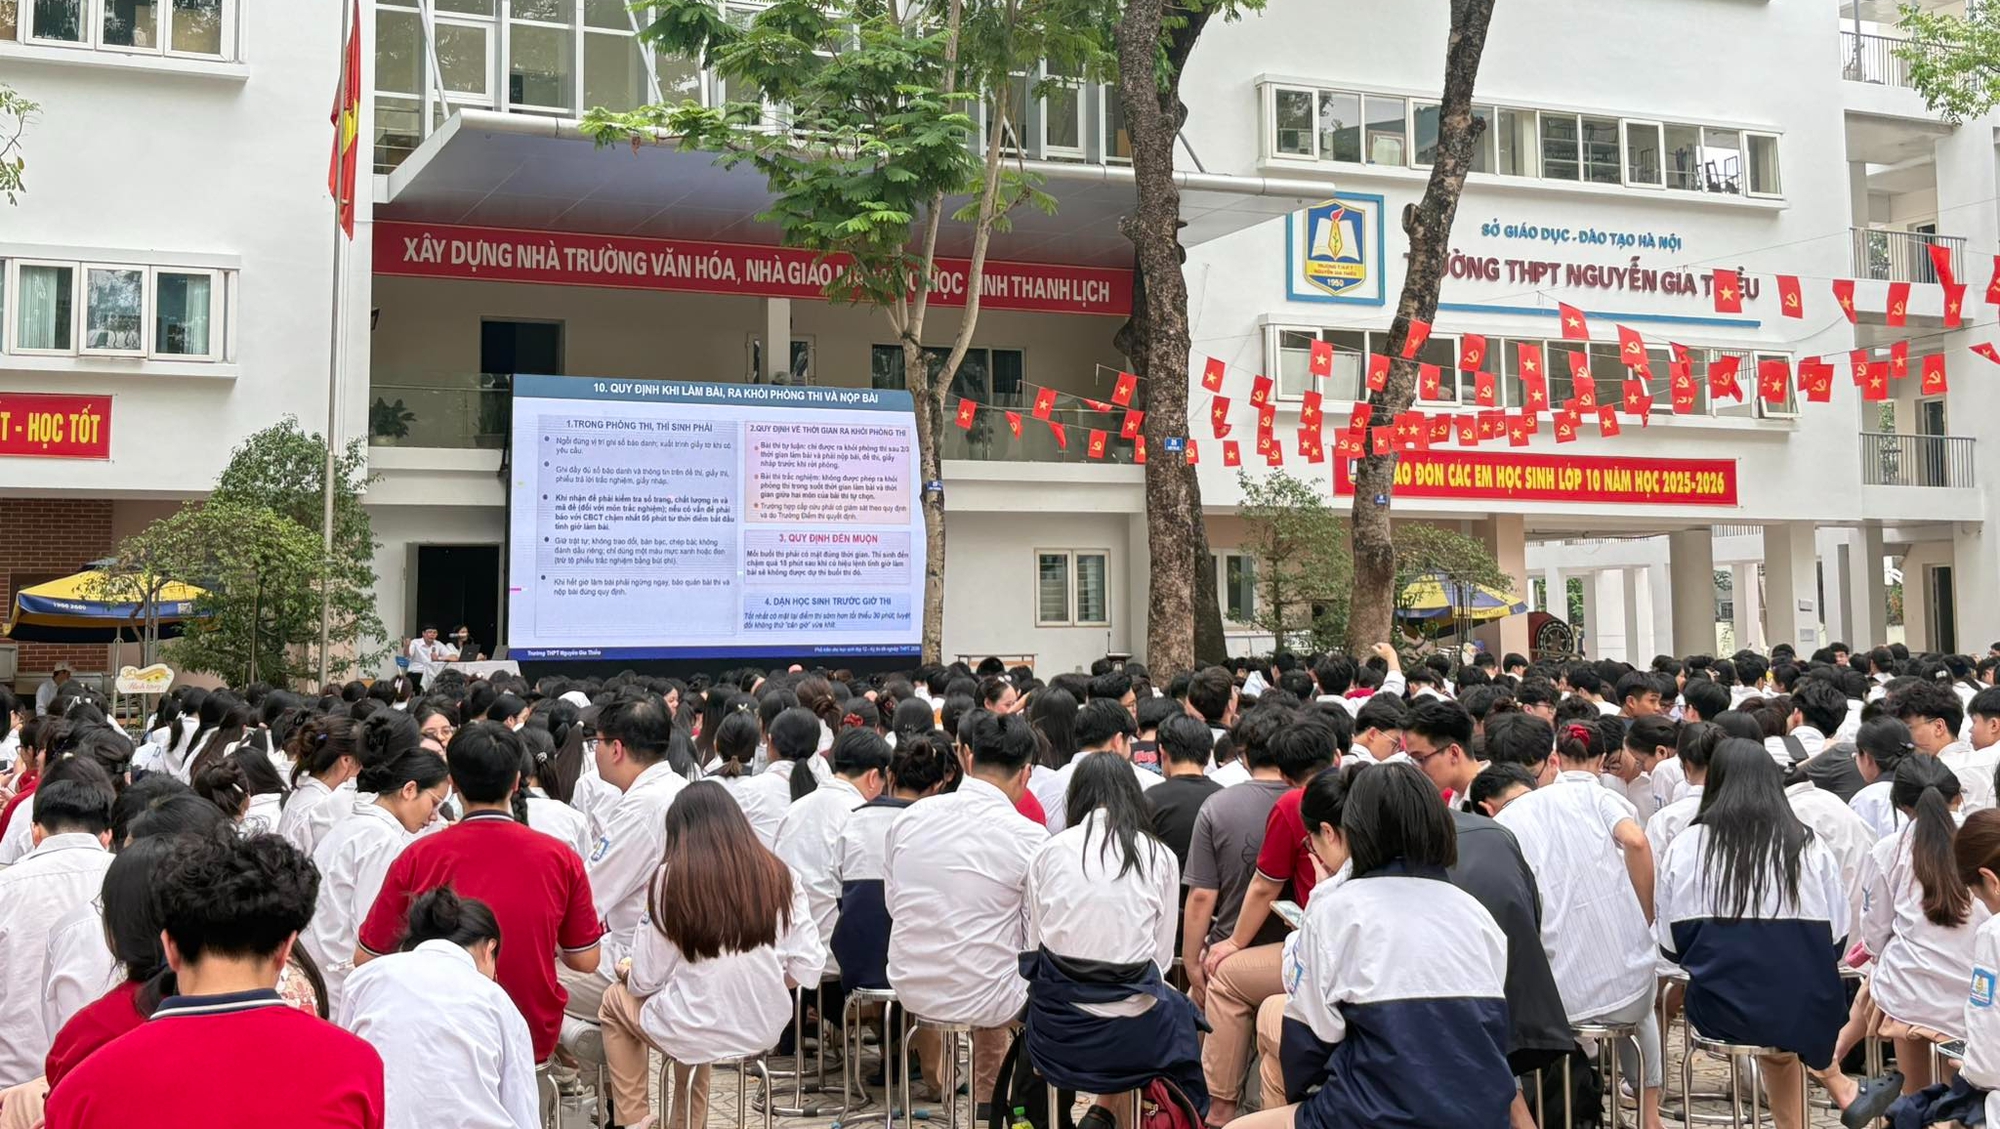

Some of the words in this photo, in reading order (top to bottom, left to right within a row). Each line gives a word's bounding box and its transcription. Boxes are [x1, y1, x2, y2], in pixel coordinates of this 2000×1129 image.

[1481, 218, 1500, 237] SỞ
[1504, 222, 1538, 239] GIÁO
[1541, 227, 1570, 245] DỤC
[1609, 232, 1635, 250] TẠO
[1638, 232, 1656, 249] HÀ
[1659, 233, 1681, 253] NỘI
[403, 232, 446, 262] XÂY
[451, 240, 511, 272] DỰNG
[518, 240, 561, 270] NHÀ
[564, 243, 646, 275] TRƯỜNG
[651, 248, 691, 278] VĂN
[695, 250, 741, 285] HÓA,
[746, 254, 785, 284] NHÀ
[928, 271, 963, 300] HỌC
[979, 274, 1008, 297] INH
[1012, 276, 1070, 300] THANH
[1073, 279, 1110, 308] LỊCH
[1505, 259, 1561, 287] THPT
[1566, 256, 1657, 293] NGUYỄN
[1660, 271, 1697, 297] GIA
[594, 383, 608, 393] 10.
[611, 383, 632, 394] QUY
[635, 384, 659, 396] ĐỊNH
[662, 386, 679, 395] KHI
[682, 384, 703, 396] LÀM
[706, 386, 725, 398] BÀI,
[728, 388, 742, 397] RA
[744, 388, 768, 399] KHỎI
[770, 388, 805, 400] PHÒNG
[807, 391, 822, 401] THI
[824, 391, 838, 402] VÀ
[840, 392, 860, 404] NỘP
[862, 392, 878, 403] BÀI
[28, 412, 64, 449] HỌC
[70, 404, 101, 443] TỐT
[566, 420, 603, 429] 1.TRONG
[605, 420, 637, 430] PHÒNG
[672, 423, 691, 431] SINH
[869, 428, 893, 436] PHÒNG
[1415, 458, 1444, 486] ĐÓN
[1448, 459, 1471, 487] CÁC
[1475, 465, 1493, 487] EM
[1496, 465, 1521, 494] HỌC
[1525, 466, 1555, 490] SINH
[1559, 462, 1582, 491] LỚP
[1586, 469, 1601, 491] 10
[1604, 466, 1632, 492] NĂM
[1635, 470, 1660, 498] HỌC
[1662, 471, 1725, 494] 2025-2026
[788, 534, 807, 542] QUY
[809, 534, 830, 544] ĐỊNH
[852, 534, 878, 544] MUỘN
[792, 597, 810, 607] HỌC
[811, 597, 830, 605] SINH
[879, 597, 891, 605] THI
